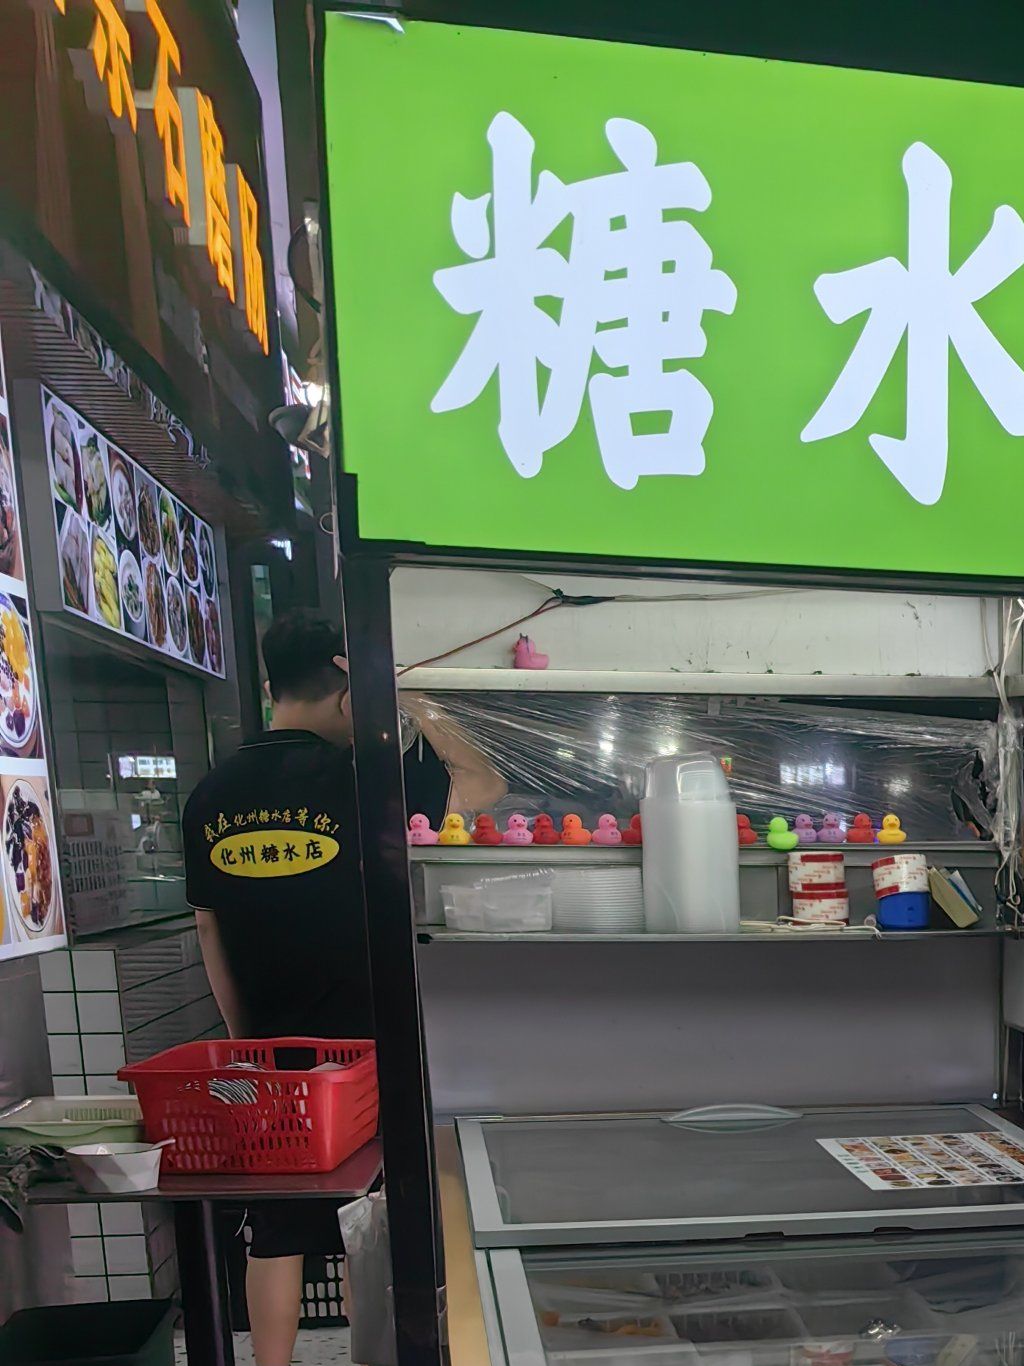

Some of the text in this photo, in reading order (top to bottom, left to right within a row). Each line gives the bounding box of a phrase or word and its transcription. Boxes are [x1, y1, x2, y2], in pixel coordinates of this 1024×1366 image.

[220, 840, 324, 866] 化州糖水店
